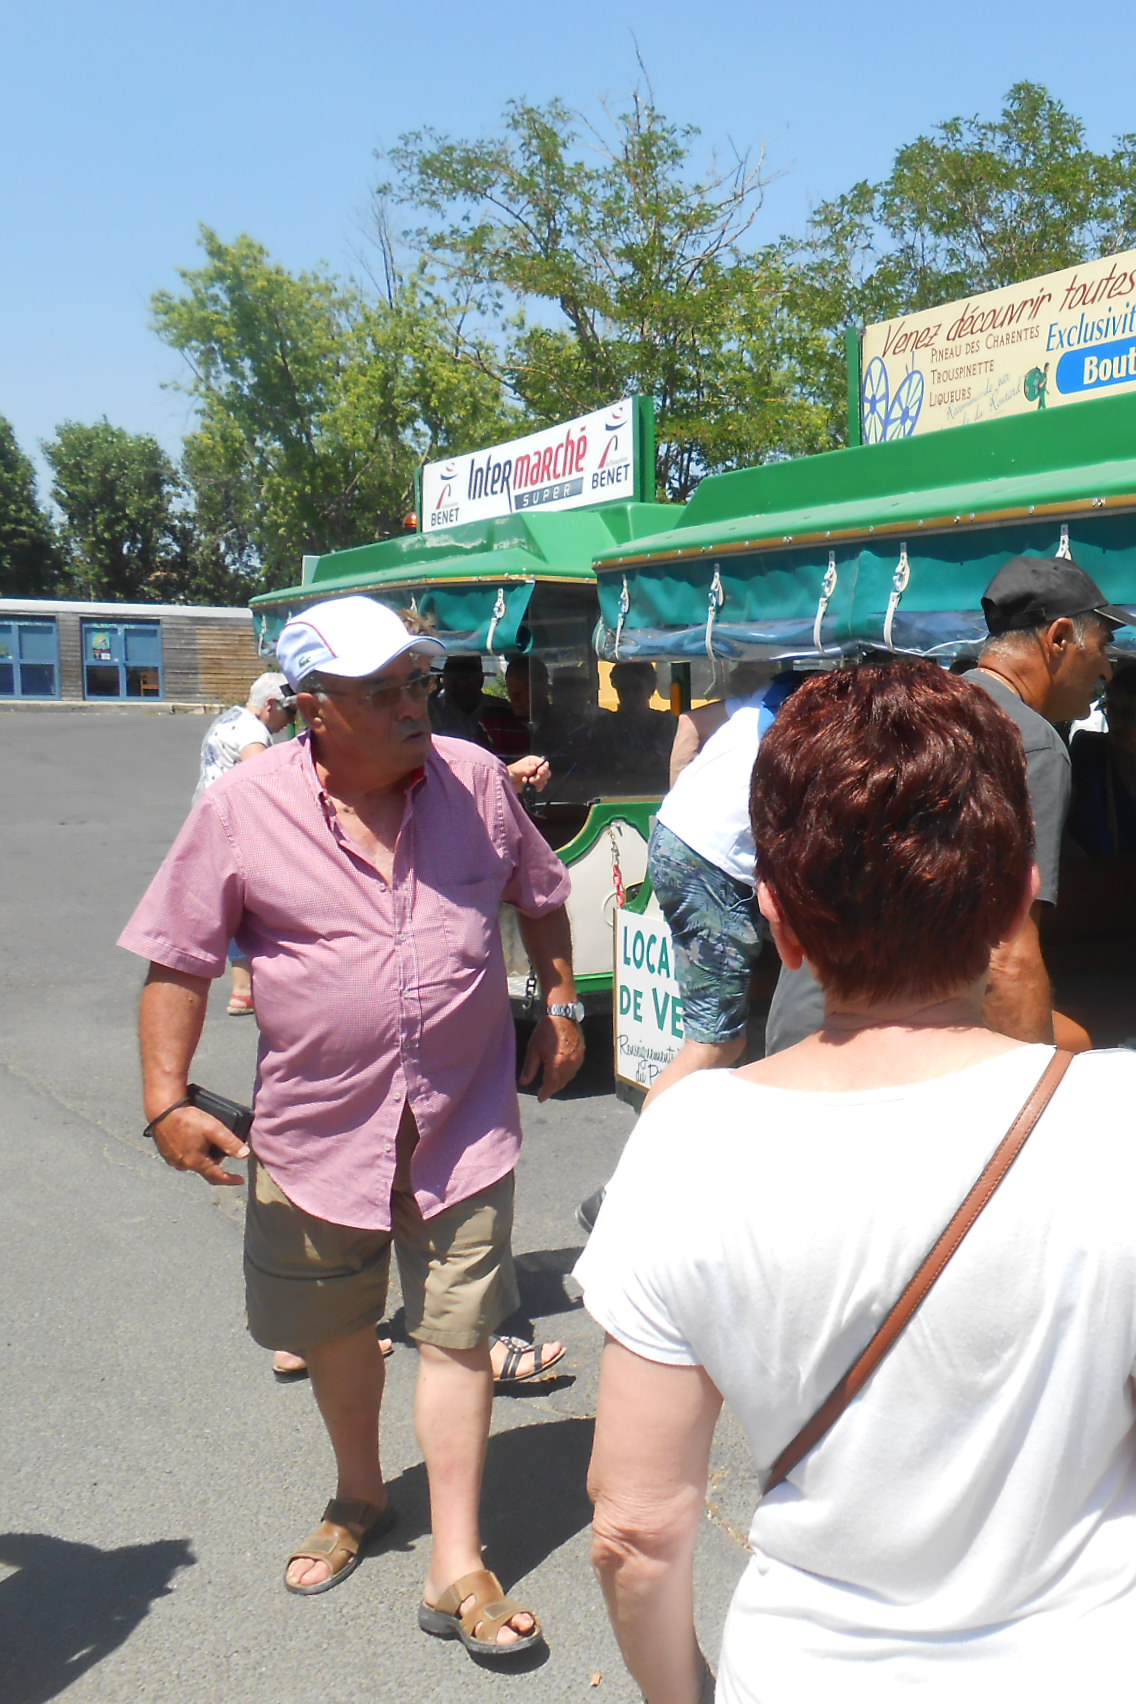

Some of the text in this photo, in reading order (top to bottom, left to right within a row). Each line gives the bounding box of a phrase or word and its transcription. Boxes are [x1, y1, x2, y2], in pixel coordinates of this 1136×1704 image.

[882, 321, 942, 358] Venez
[946, 287, 1052, 342] découvrir
[591, 463, 630, 489] BENET
[431, 507, 460, 527] BENET
[623, 926, 670, 978] LOCA
[620, 984, 684, 1039] DE VE
